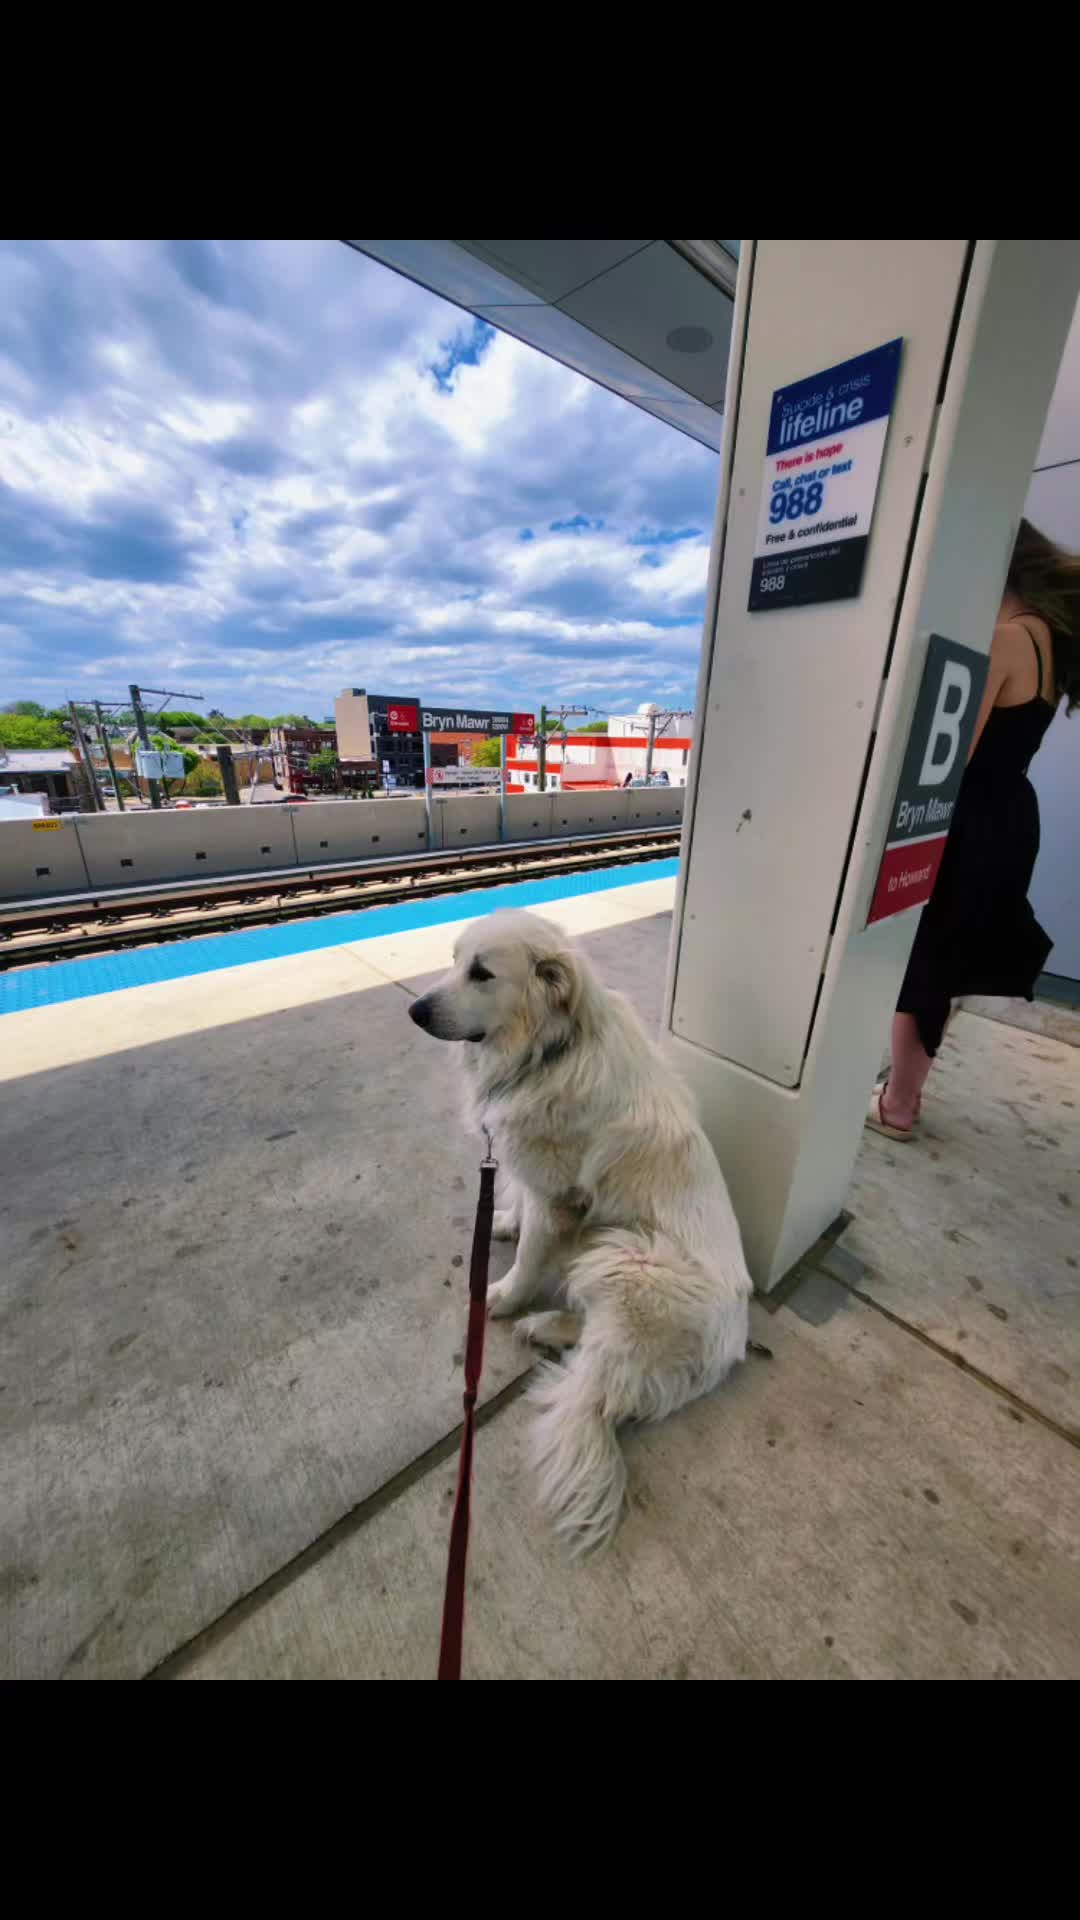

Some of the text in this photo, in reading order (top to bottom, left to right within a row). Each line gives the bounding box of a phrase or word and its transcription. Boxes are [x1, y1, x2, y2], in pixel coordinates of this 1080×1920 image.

[782, 374, 872, 417] Suicide & crisis
[779, 397, 865, 445] lifeline
[776, 443, 844, 472] There is hope
[794, 470, 817, 486] chat
[818, 467, 831, 479] or
[831, 459, 853, 475] text
[769, 481, 824, 524] 988
[765, 513, 858, 545] Free & confidential
[759, 575, 786, 593] 988
[423, 712, 455, 731] Bryn
[456, 714, 489, 729] Mawr
[918, 660, 972, 786] B
[896, 797, 954, 833] Bryn Mawr
[898, 864, 932, 889] Howard
